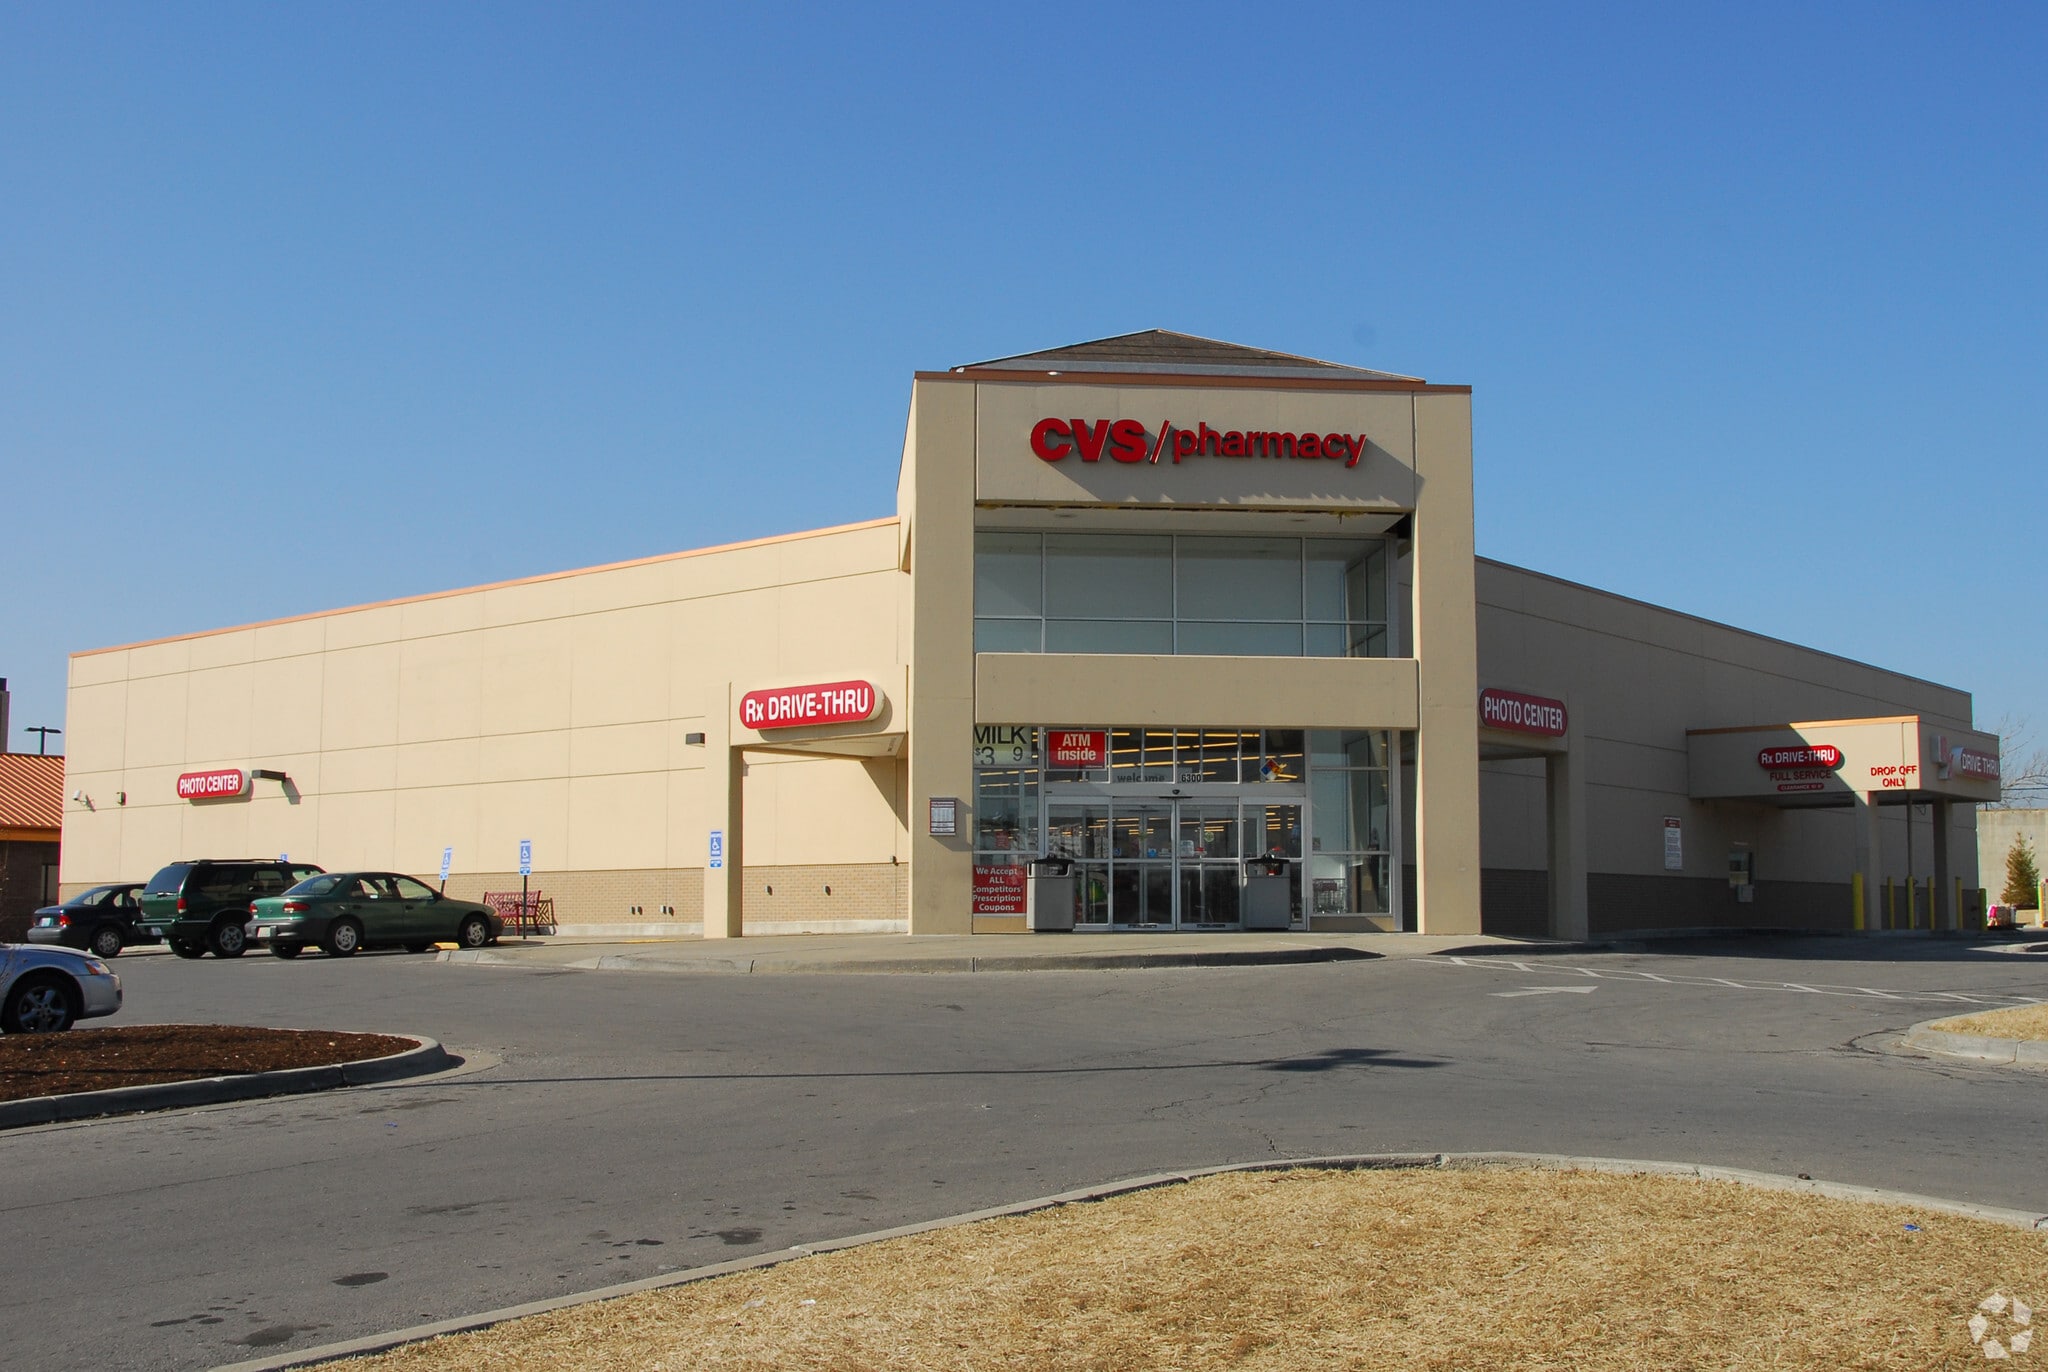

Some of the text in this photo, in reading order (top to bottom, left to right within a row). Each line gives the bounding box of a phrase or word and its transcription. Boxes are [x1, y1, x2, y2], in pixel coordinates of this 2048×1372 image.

[1030, 417, 1367, 468] CVS/pharmacy
[745, 687, 869, 723] Rx DRIVE-THRU
[1484, 697, 1563, 731] PHOTO CENTER
[974, 726, 1027, 744] MILK
[1062, 733, 1091, 747] ATM
[1057, 747, 1096, 761] inside
[1761, 748, 1835, 764] Rx DRIVE-THRU
[1962, 753, 1982, 772] DRIVE
[1769, 769, 1832, 782] FULL SERVICE
[1870, 765, 1918, 776] DROP OFF
[180, 774, 239, 794] PHOTO CENTER
[1181, 773, 1202, 783] 6300
[1882, 777, 1906, 788] ONLY
[976, 867, 1018, 876] We Accept
[989, 876, 1005, 884] ALL
[973, 894, 1021, 903] Prescription
[978, 903, 1015, 912] Coupons
